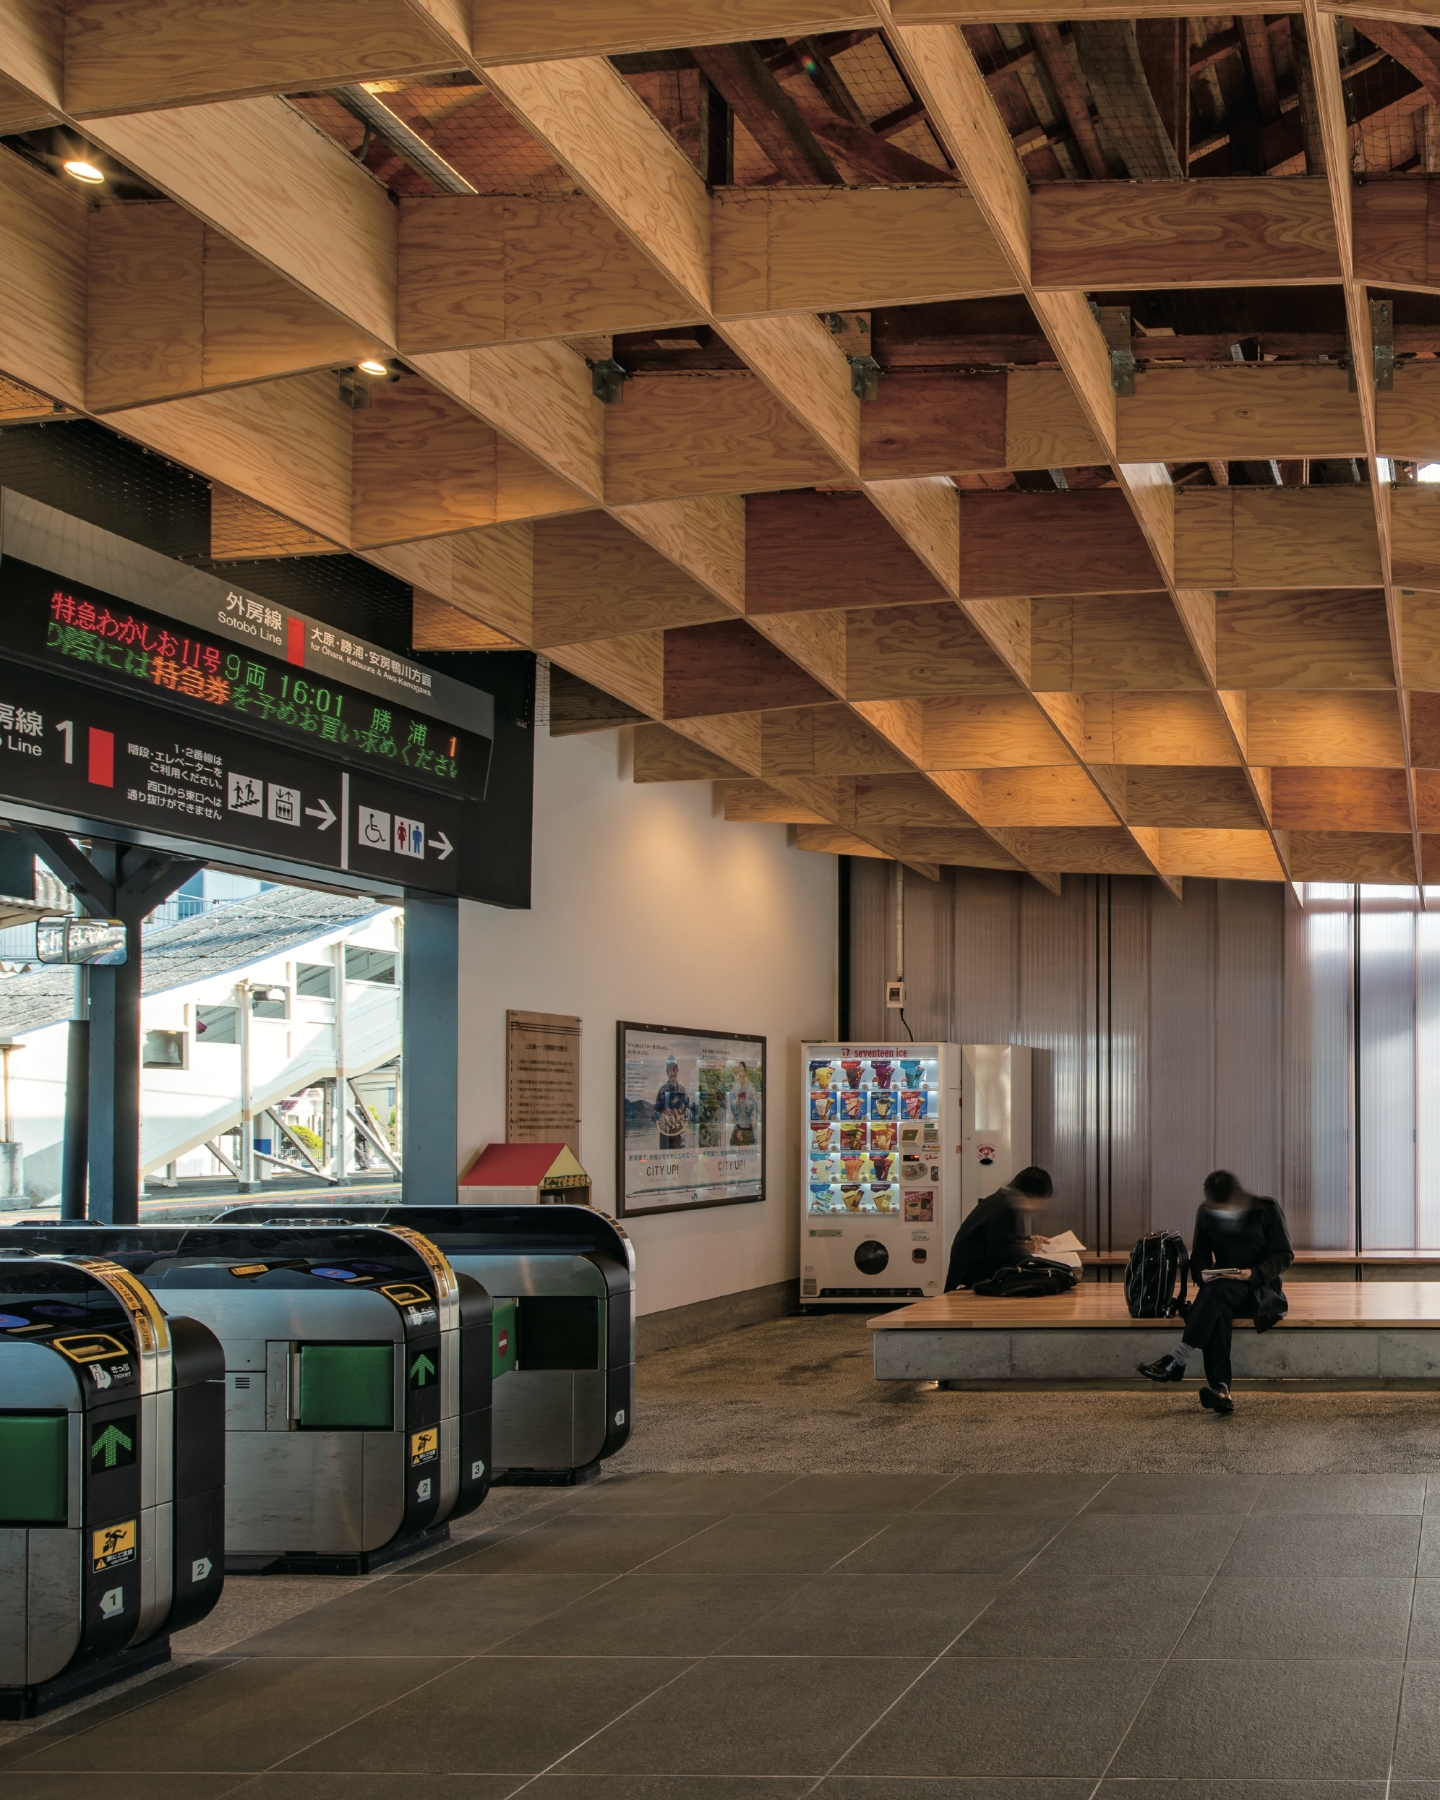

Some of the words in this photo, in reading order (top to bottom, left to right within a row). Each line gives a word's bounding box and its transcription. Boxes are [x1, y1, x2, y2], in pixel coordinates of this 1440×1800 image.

[226, 591, 282, 631] 外房線
[260, 629, 283, 646] Line
[311, 628, 432, 688] 大原・勝浦・安房鴨川方面
[51, 592, 221, 673] 特急わかしお11号
[281, 675, 344, 718] 16:01
[449, 736, 457, 758] 1
[310, 641, 321, 652] for
[346, 654, 376, 675] Katsuura
[376, 669, 382, 677] &
[383, 671, 432, 697] Awa-Kamogawa
[8, 735, 43, 757] Line
[55, 720, 74, 765] 1
[127, 743, 223, 778] 階段・エレベーターを
[174, 744, 223, 766] 1・2番線は
[150, 762, 223, 790] ご利用ください。
[147, 780, 223, 808] 西口から東口へは
[127, 789, 223, 820] 通り抜けができません
[854, 1047, 895, 1058] seventeen
[896, 1047, 908, 1058] ice
[646, 1164, 665, 1177] CITY
[666, 1163, 680, 1175] UP!
[717, 1160, 733, 1172] CITY
[734, 1159, 746, 1170] UP!
[110, 1362, 131, 1374] きっぷ
[112, 1371, 132, 1380] TICKET
[618, 1413, 623, 1422] 3
[474, 1464, 480, 1475] 3
[422, 1483, 429, 1494] 2
[196, 1563, 205, 1577] 2
[109, 1593, 117, 1607] 1
